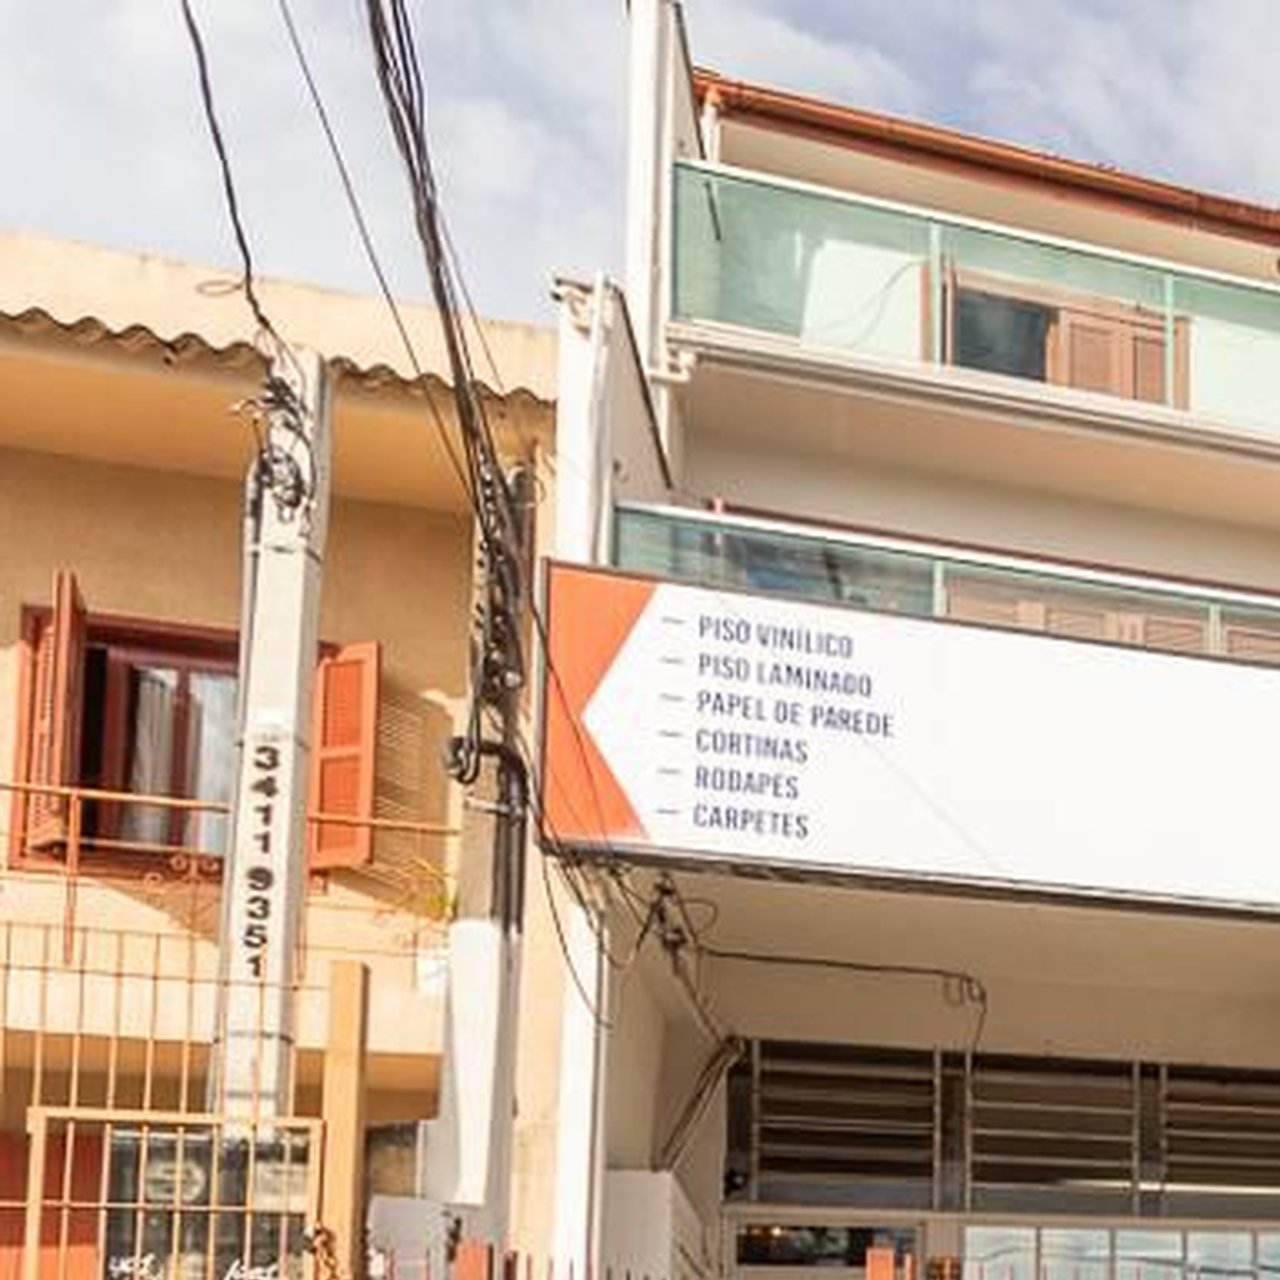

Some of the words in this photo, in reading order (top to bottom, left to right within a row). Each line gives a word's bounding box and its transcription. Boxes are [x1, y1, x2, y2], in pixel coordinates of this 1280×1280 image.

[699, 614, 751, 645] PISO
[699, 653, 749, 683] PISO
[755, 661, 872, 698] LAMINADO
[697, 690, 768, 722] PAPEL
[774, 698, 802, 725] DE
[810, 705, 895, 738] PAREDE
[696, 728, 809, 764] CORTINAS
[692, 802, 810, 840] CARPETES
